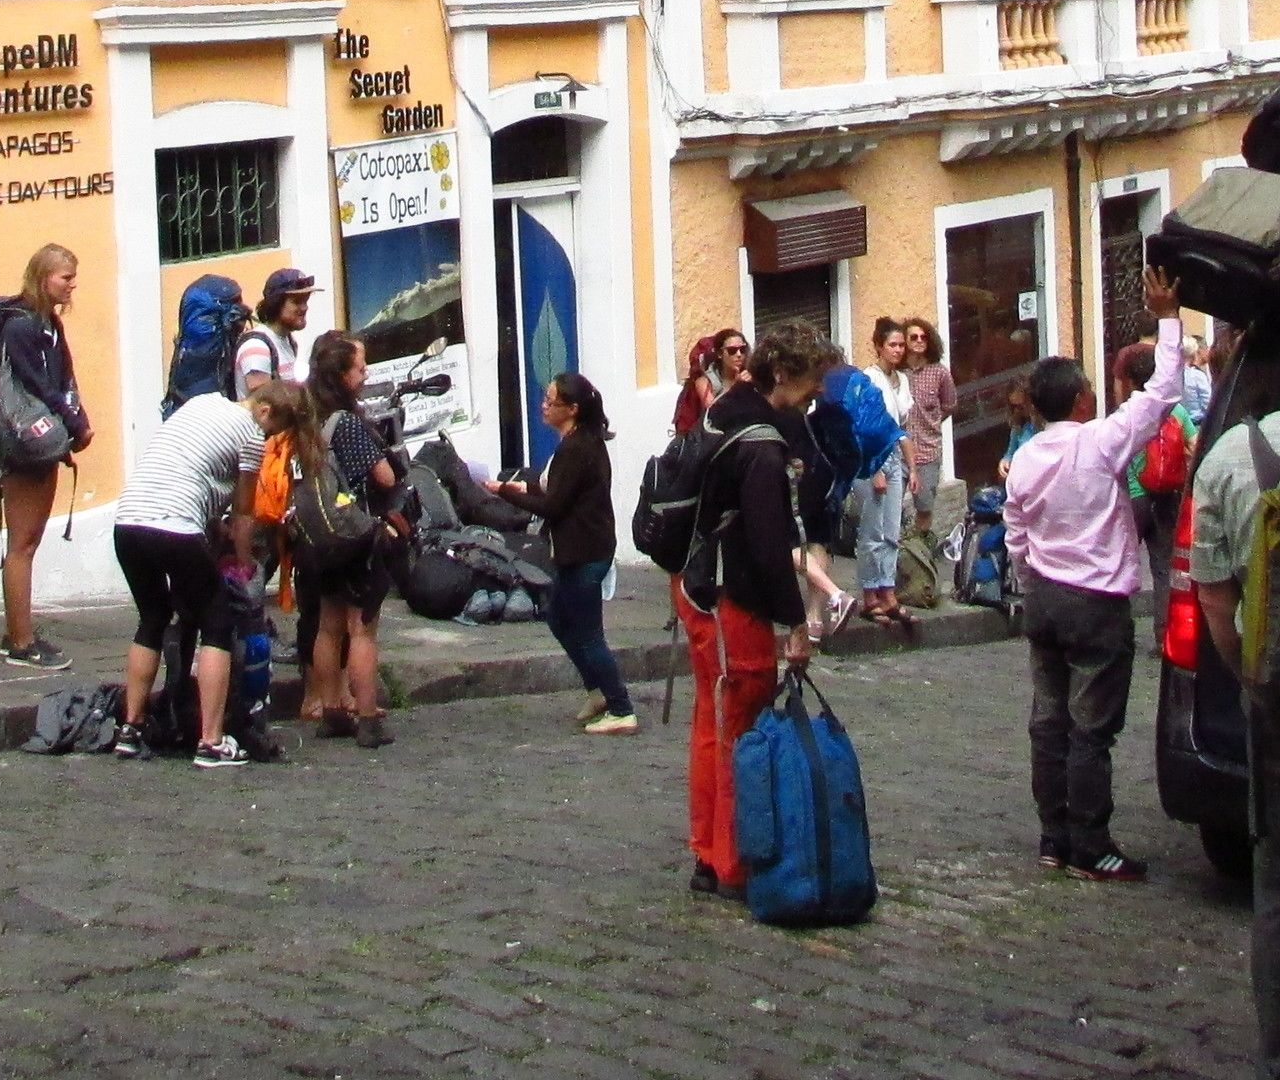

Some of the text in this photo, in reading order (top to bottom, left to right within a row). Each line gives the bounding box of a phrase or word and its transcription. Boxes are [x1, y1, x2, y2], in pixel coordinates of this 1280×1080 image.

[335, 27, 370, 59] The
[349, 64, 412, 99] Secret
[381, 100, 444, 134] Garden
[359, 143, 431, 181] Cotopaxi
[7, 180, 46, 205] DAY
[47, 171, 115, 201] TOURS
[361, 186, 429, 224] Is Open!
